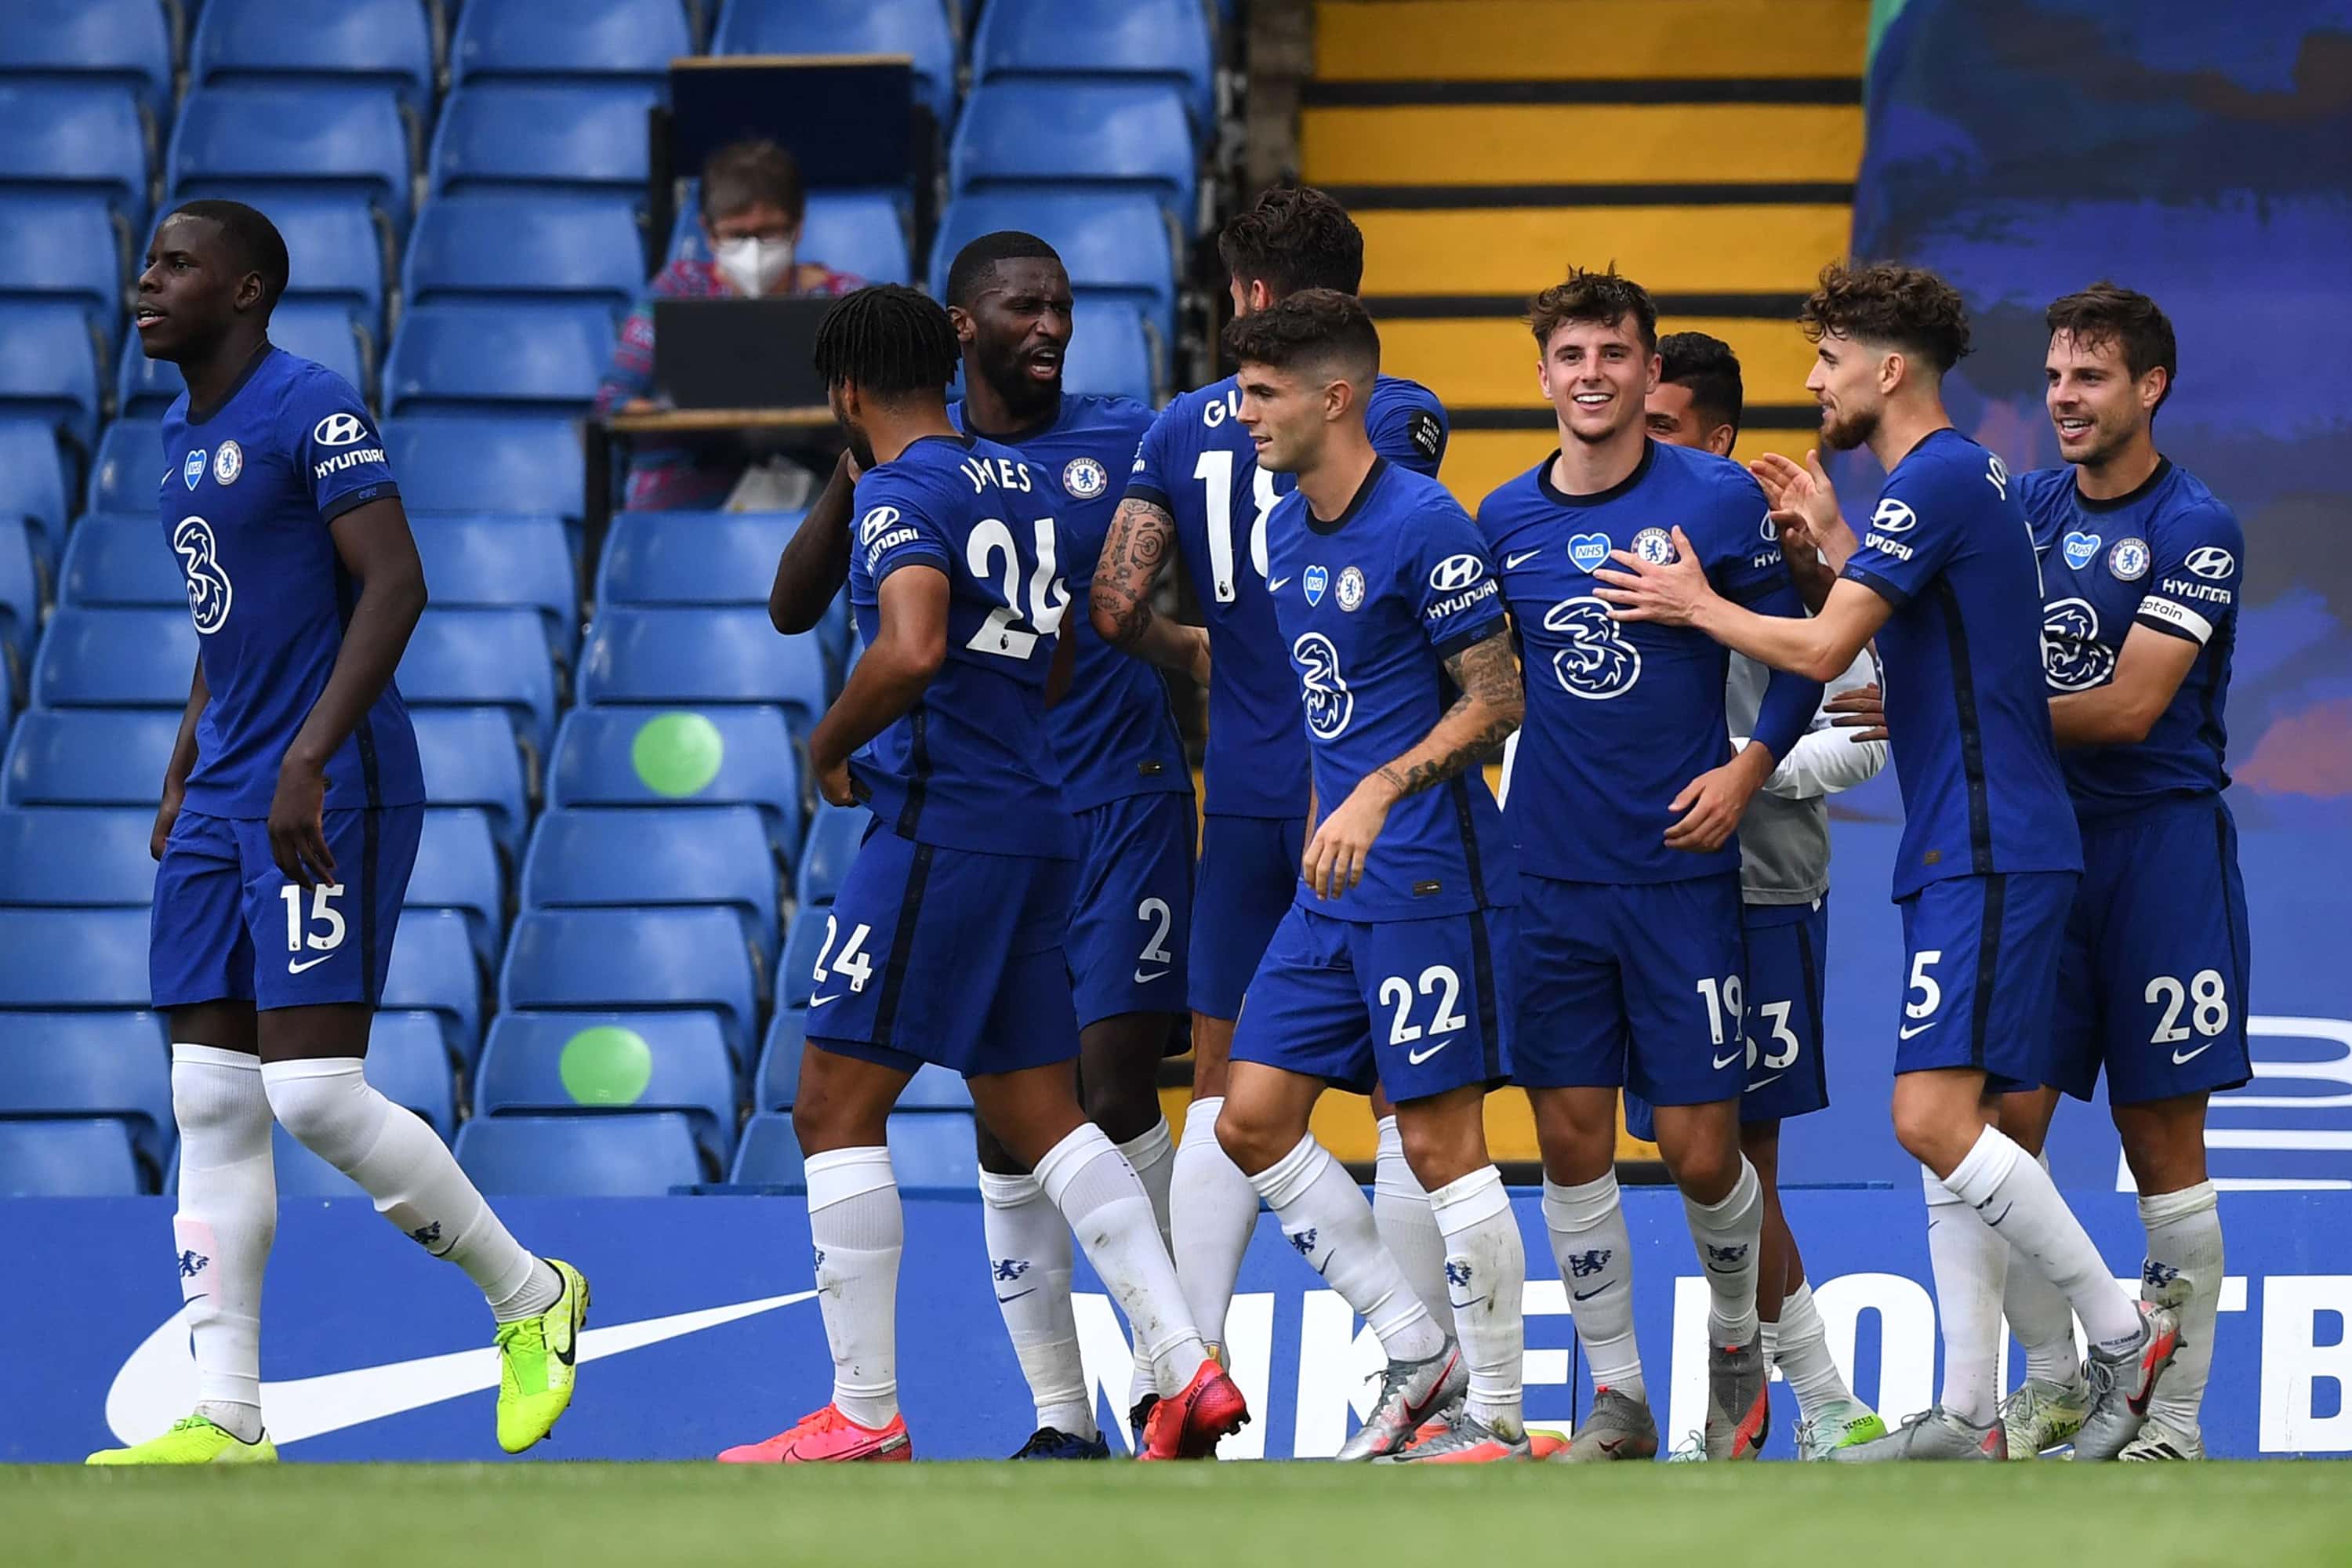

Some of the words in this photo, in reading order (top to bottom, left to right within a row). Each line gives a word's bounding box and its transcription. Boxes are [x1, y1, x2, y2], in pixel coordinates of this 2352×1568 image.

[1577, 546, 1602, 557] NHS
[2069, 543, 2091, 556] NHS
[966, 517, 1071, 660] 24
[1427, 578, 1499, 620] HYUNDAI
[280, 884, 346, 952] 15
[1138, 897, 1171, 964] 2
[812, 914, 873, 993] 24
[1905, 950, 1941, 1019] 5
[1379, 964, 1466, 1046] 22
[1697, 975, 1743, 1046] 19
[2144, 969, 2229, 1044] 28
